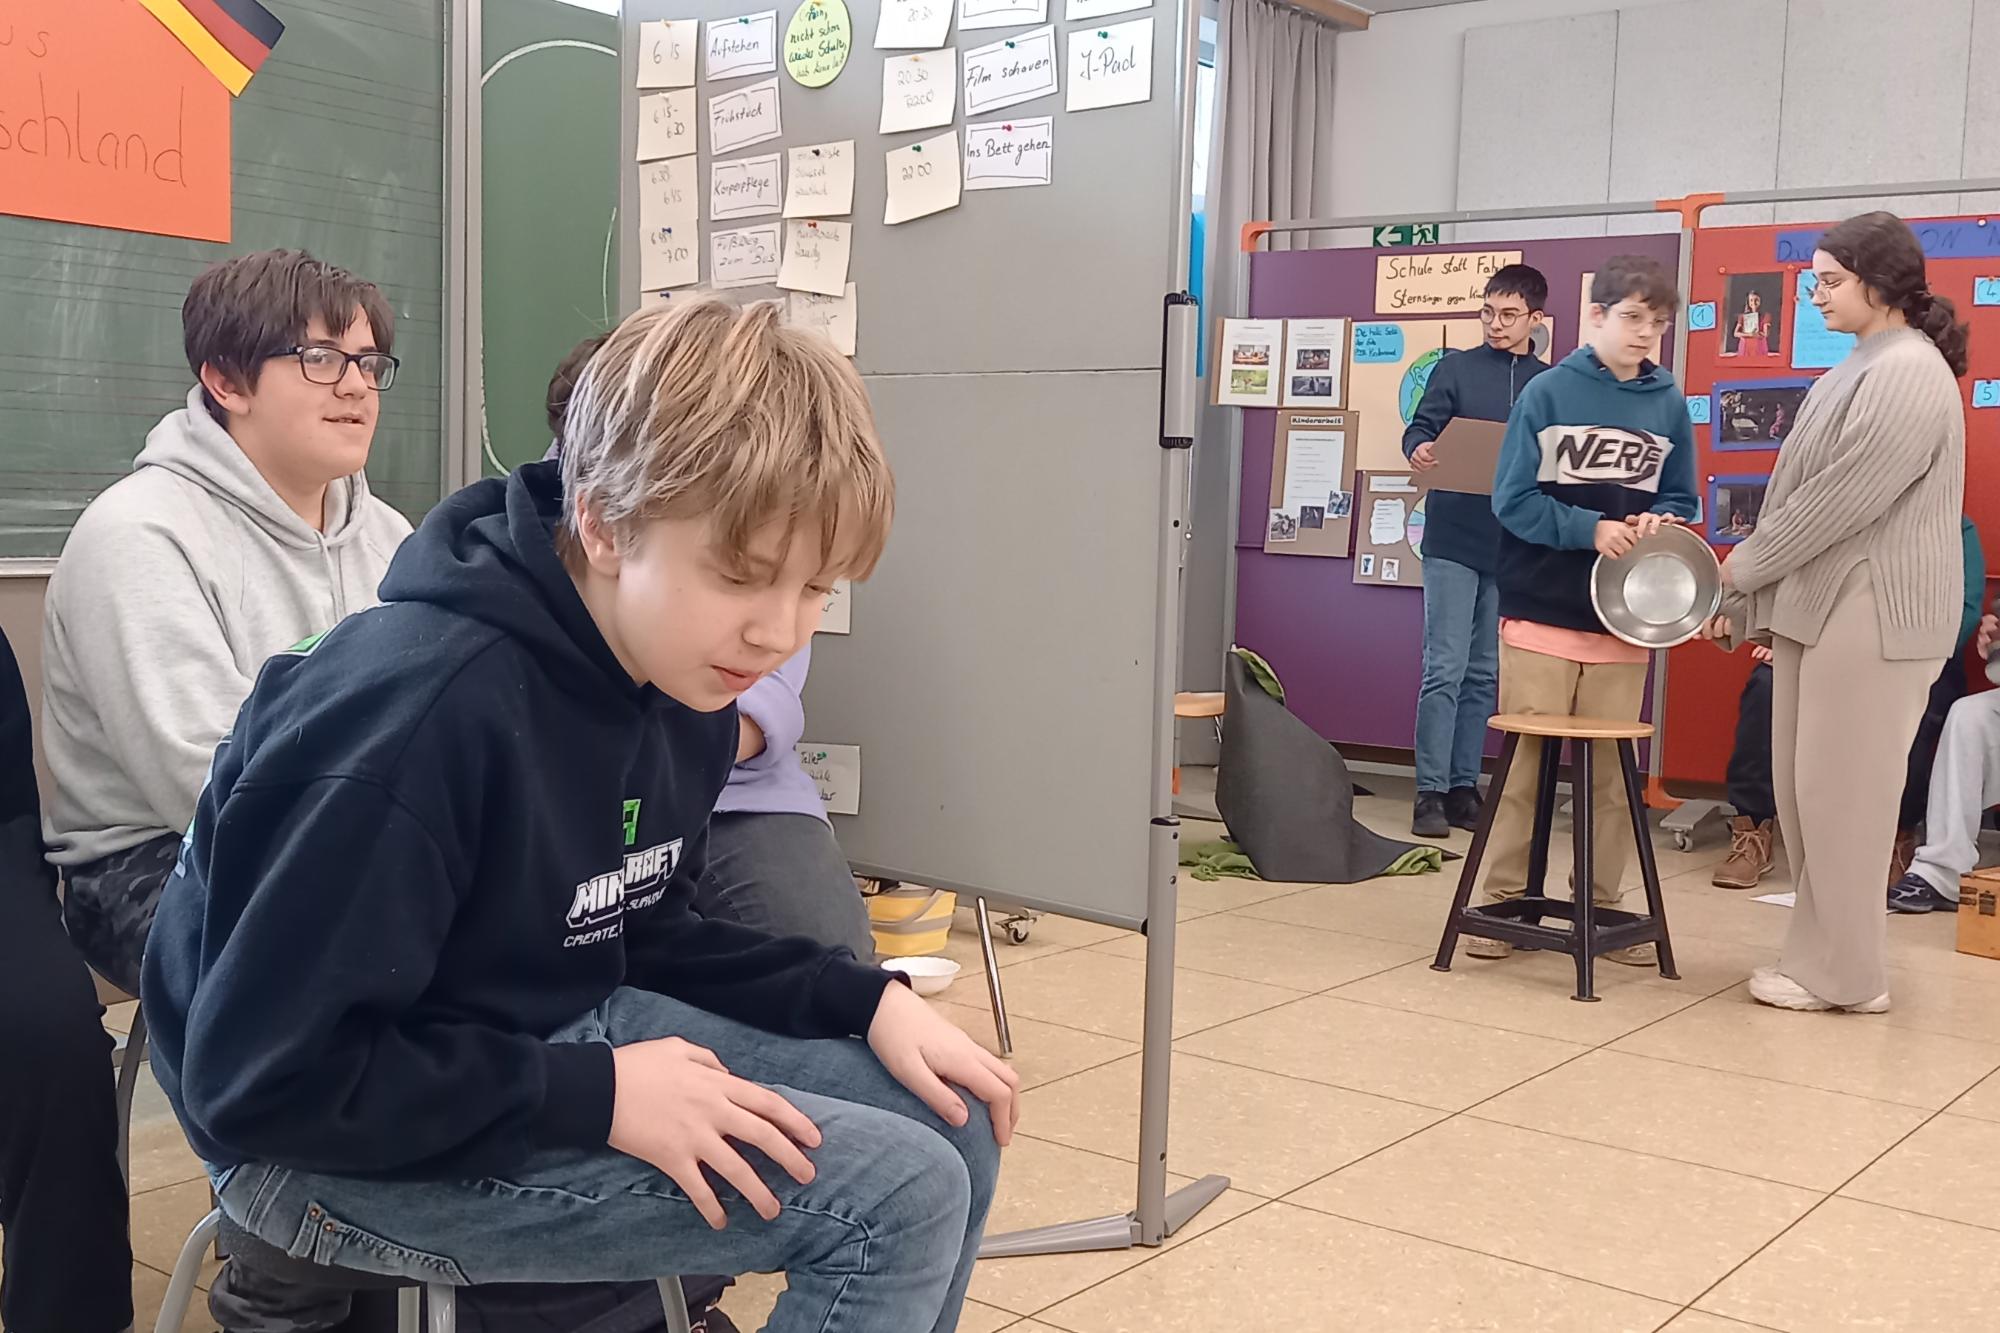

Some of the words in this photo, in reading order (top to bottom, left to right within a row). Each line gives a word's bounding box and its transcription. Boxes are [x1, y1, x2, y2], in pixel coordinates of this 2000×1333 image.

[965, 65, 992, 88] Film
[1001, 58, 1050, 79] schauen
[967, 143, 981, 158] Ins
[984, 138, 1013, 158] Bett
[1016, 138, 1051, 166] gehen
[1386, 255, 1433, 280] Schule
[1441, 255, 1469, 276] statt
[1983, 385, 1993, 401] 5
[1691, 401, 1704, 417] 2
[1556, 433, 1663, 473] NERF
